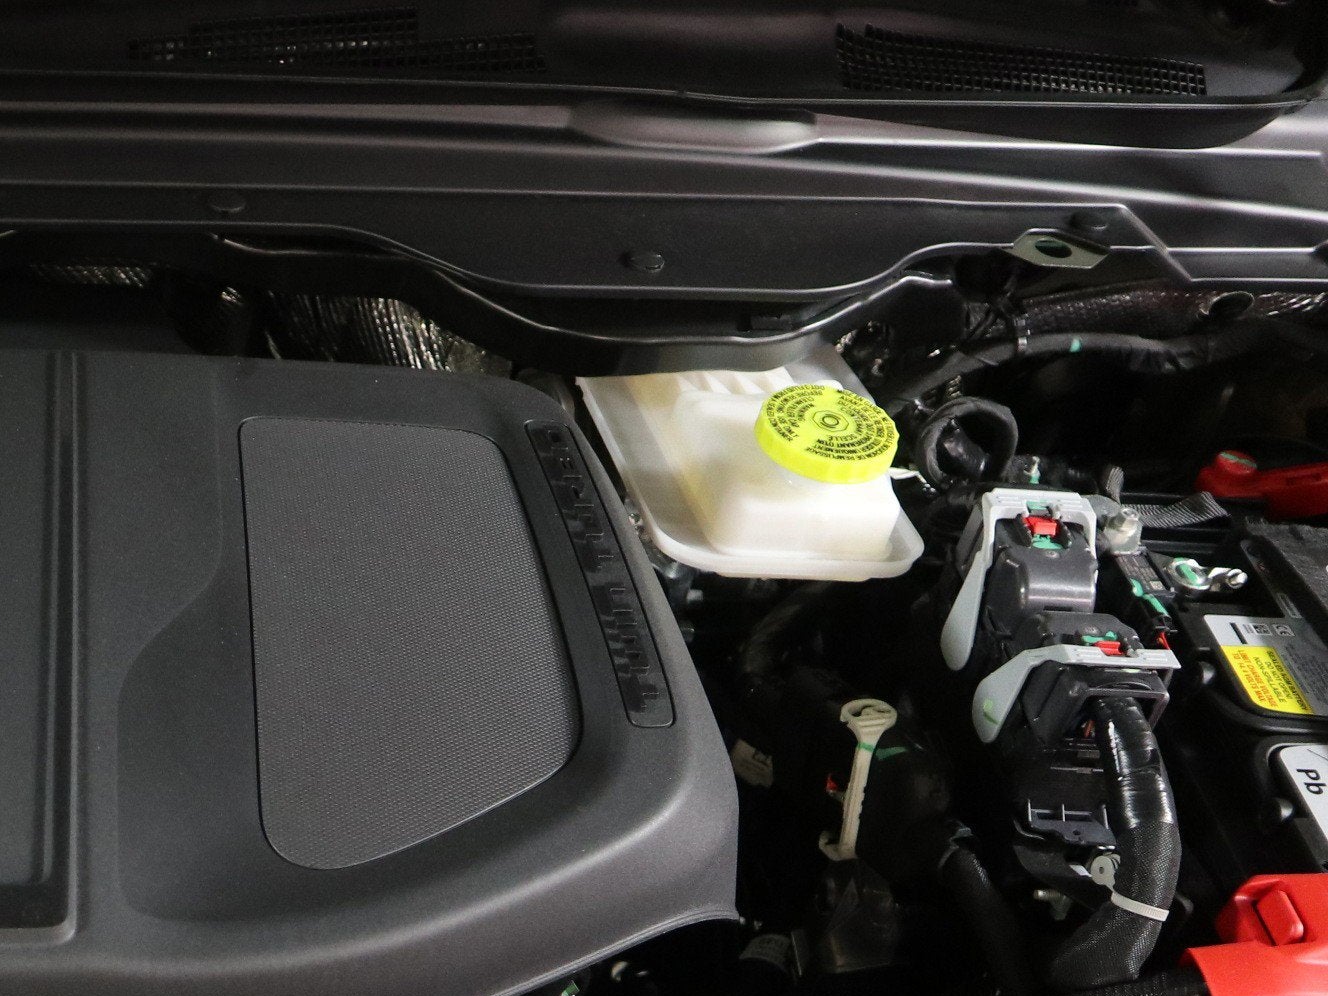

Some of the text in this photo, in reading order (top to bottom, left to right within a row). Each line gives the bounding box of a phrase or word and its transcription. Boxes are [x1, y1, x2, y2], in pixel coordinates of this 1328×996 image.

[1258, 684, 1278, 707] VOLTAGE
[1287, 685, 1309, 710] BATTERY
[1295, 768, 1327, 795] Pb
